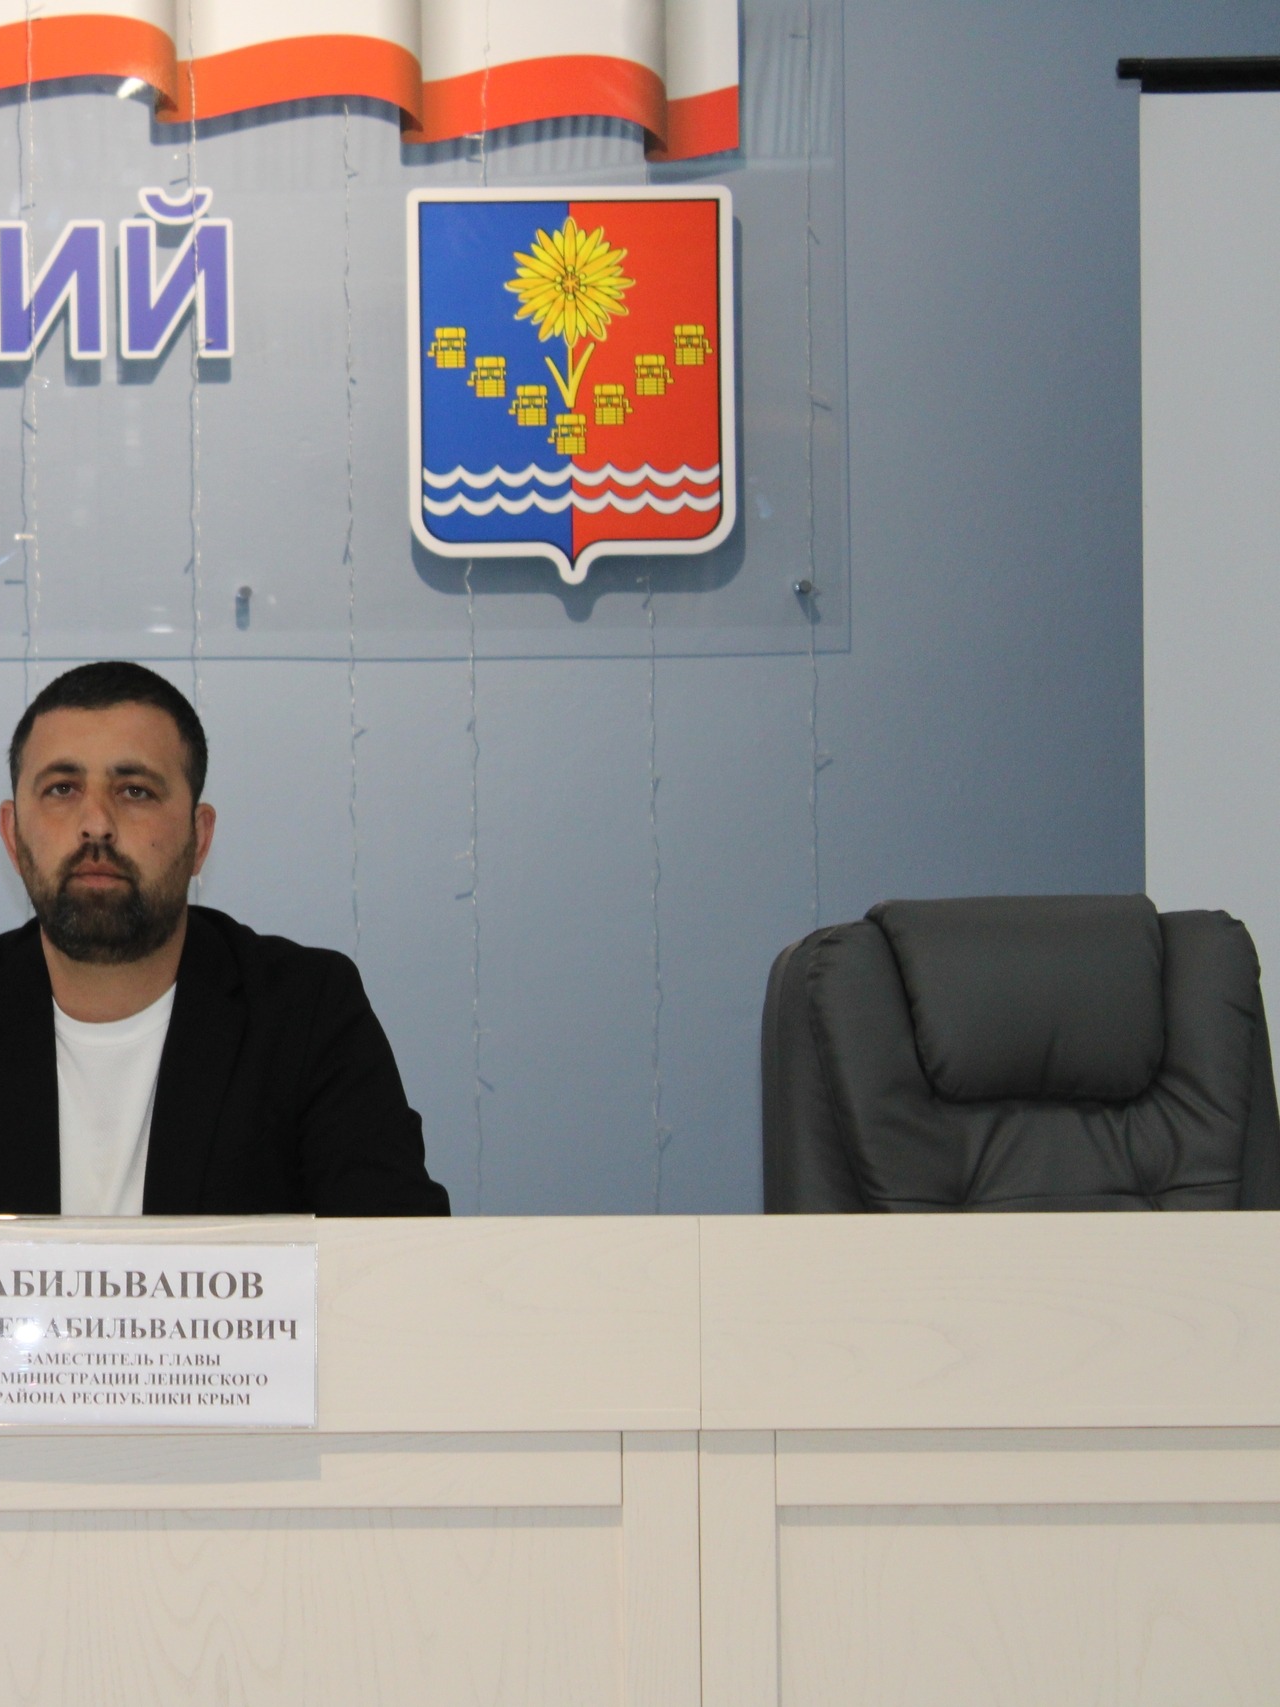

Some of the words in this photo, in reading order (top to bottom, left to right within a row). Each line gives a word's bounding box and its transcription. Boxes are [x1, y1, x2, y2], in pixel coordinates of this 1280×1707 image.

[44, 1317, 299, 1341] АБИЛЬВАПОВИЧ
[159, 1353, 222, 1367] ГЛАВЫ
[144, 1373, 270, 1388] ЛЕНИНСКОГО
[72, 1391, 192, 1407] РЕСПУБЛИКИ
[196, 1392, 252, 1407] КРЫМ
